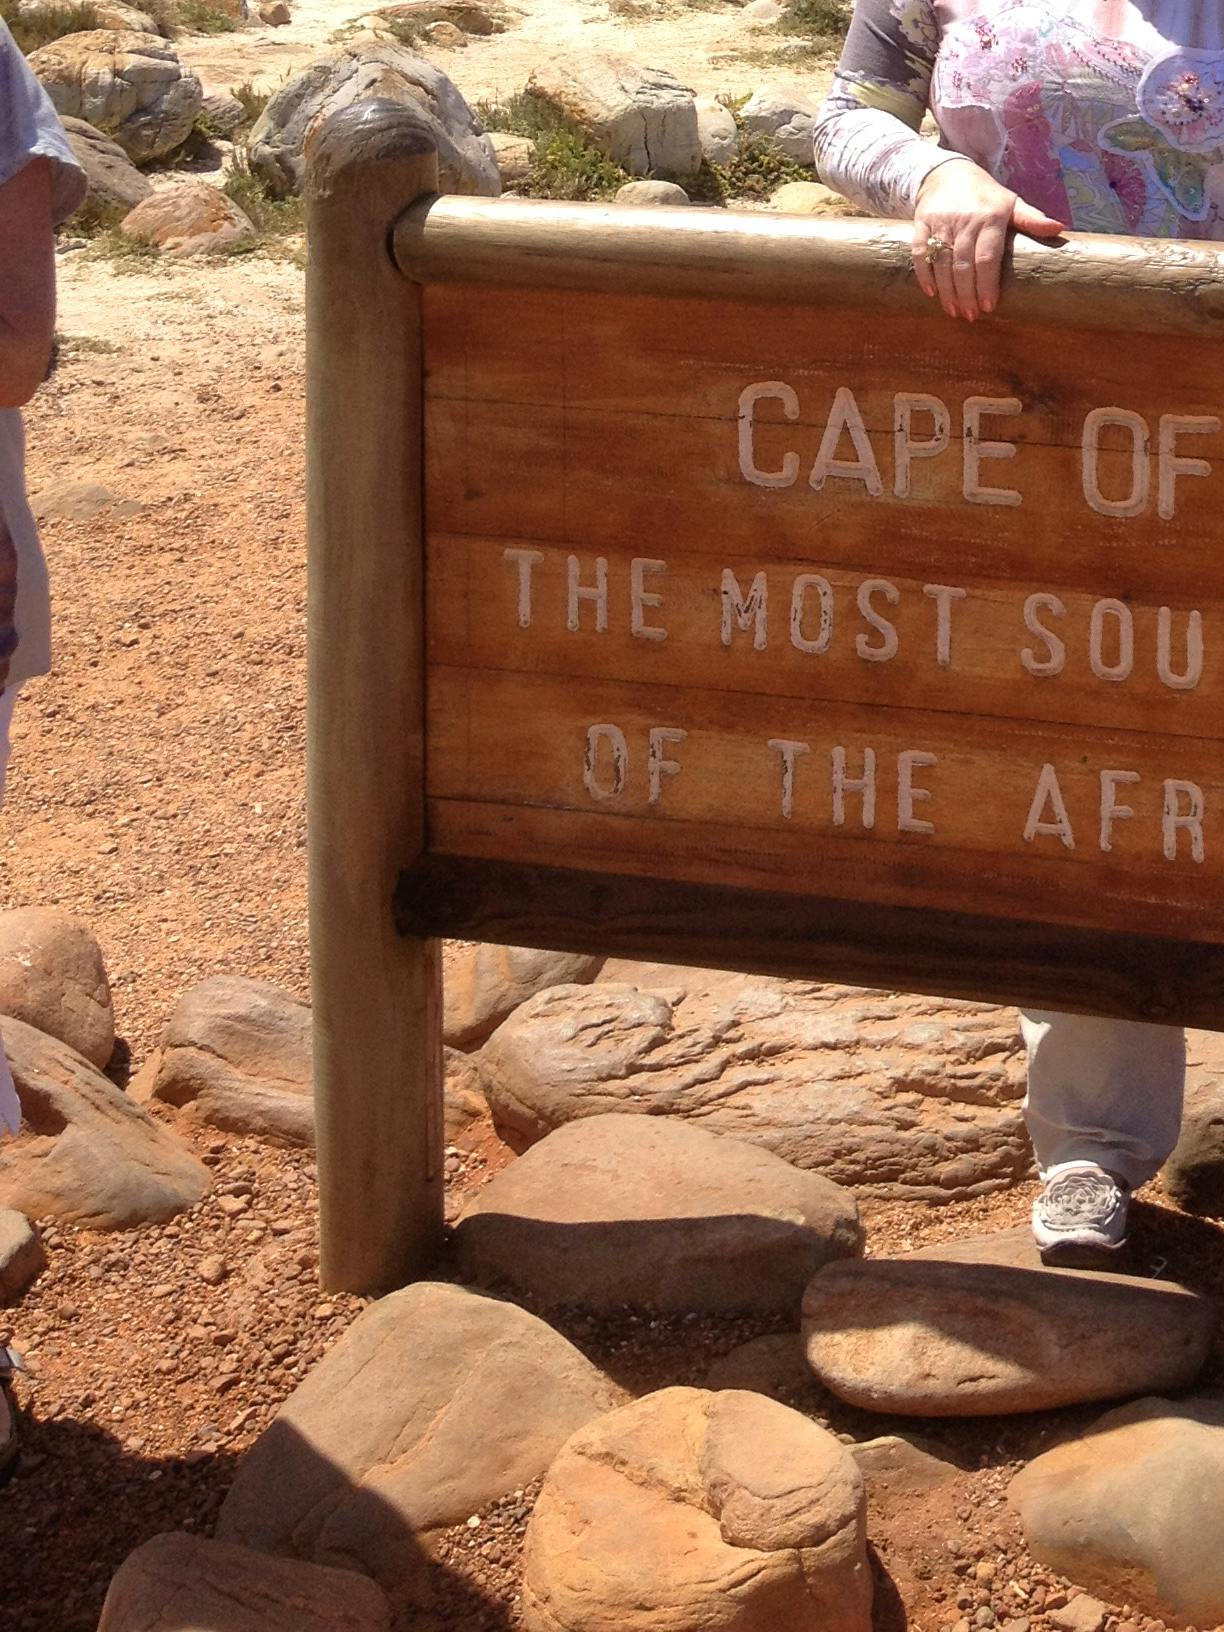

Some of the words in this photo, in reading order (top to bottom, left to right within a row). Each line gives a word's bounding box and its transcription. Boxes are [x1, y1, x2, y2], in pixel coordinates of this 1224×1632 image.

[737, 380, 1023, 507] CAPE
[1081, 406, 1222, 520] OF
[503, 548, 670, 643] THE
[720, 567, 967, 667] MOST
[582, 722, 688, 807] OF
[767, 738, 938, 835] THE
